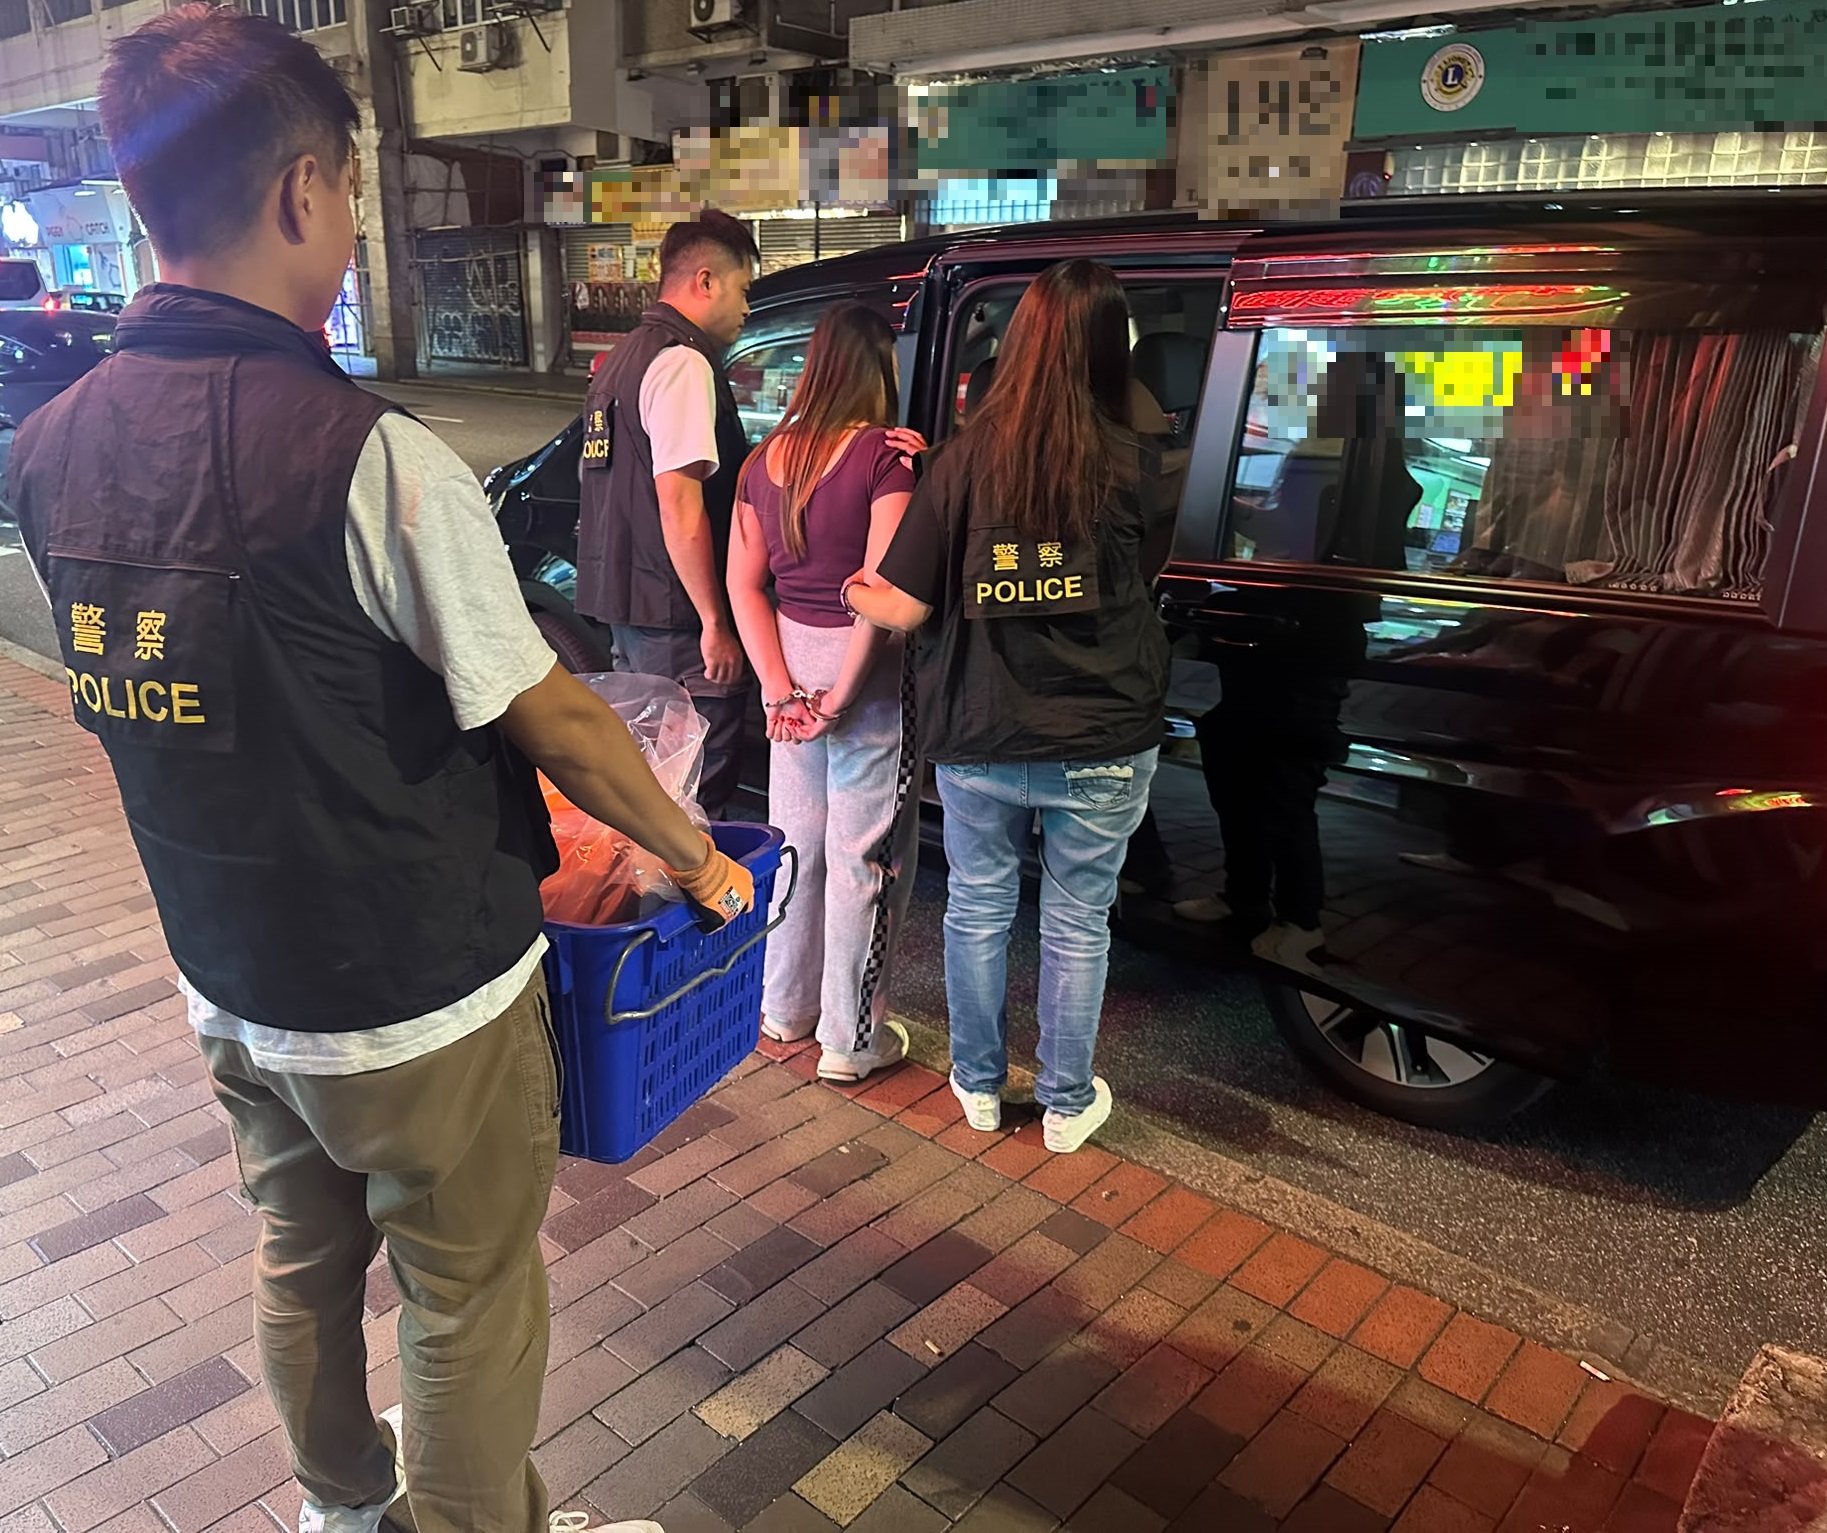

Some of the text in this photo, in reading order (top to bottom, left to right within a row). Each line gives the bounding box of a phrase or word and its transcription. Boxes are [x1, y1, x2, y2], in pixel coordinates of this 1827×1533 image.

[1445, 67, 1459, 85] L
[992, 542, 1063, 571] 警察
[977, 575, 1083, 604] POLICE
[71, 602, 167, 661] 警察
